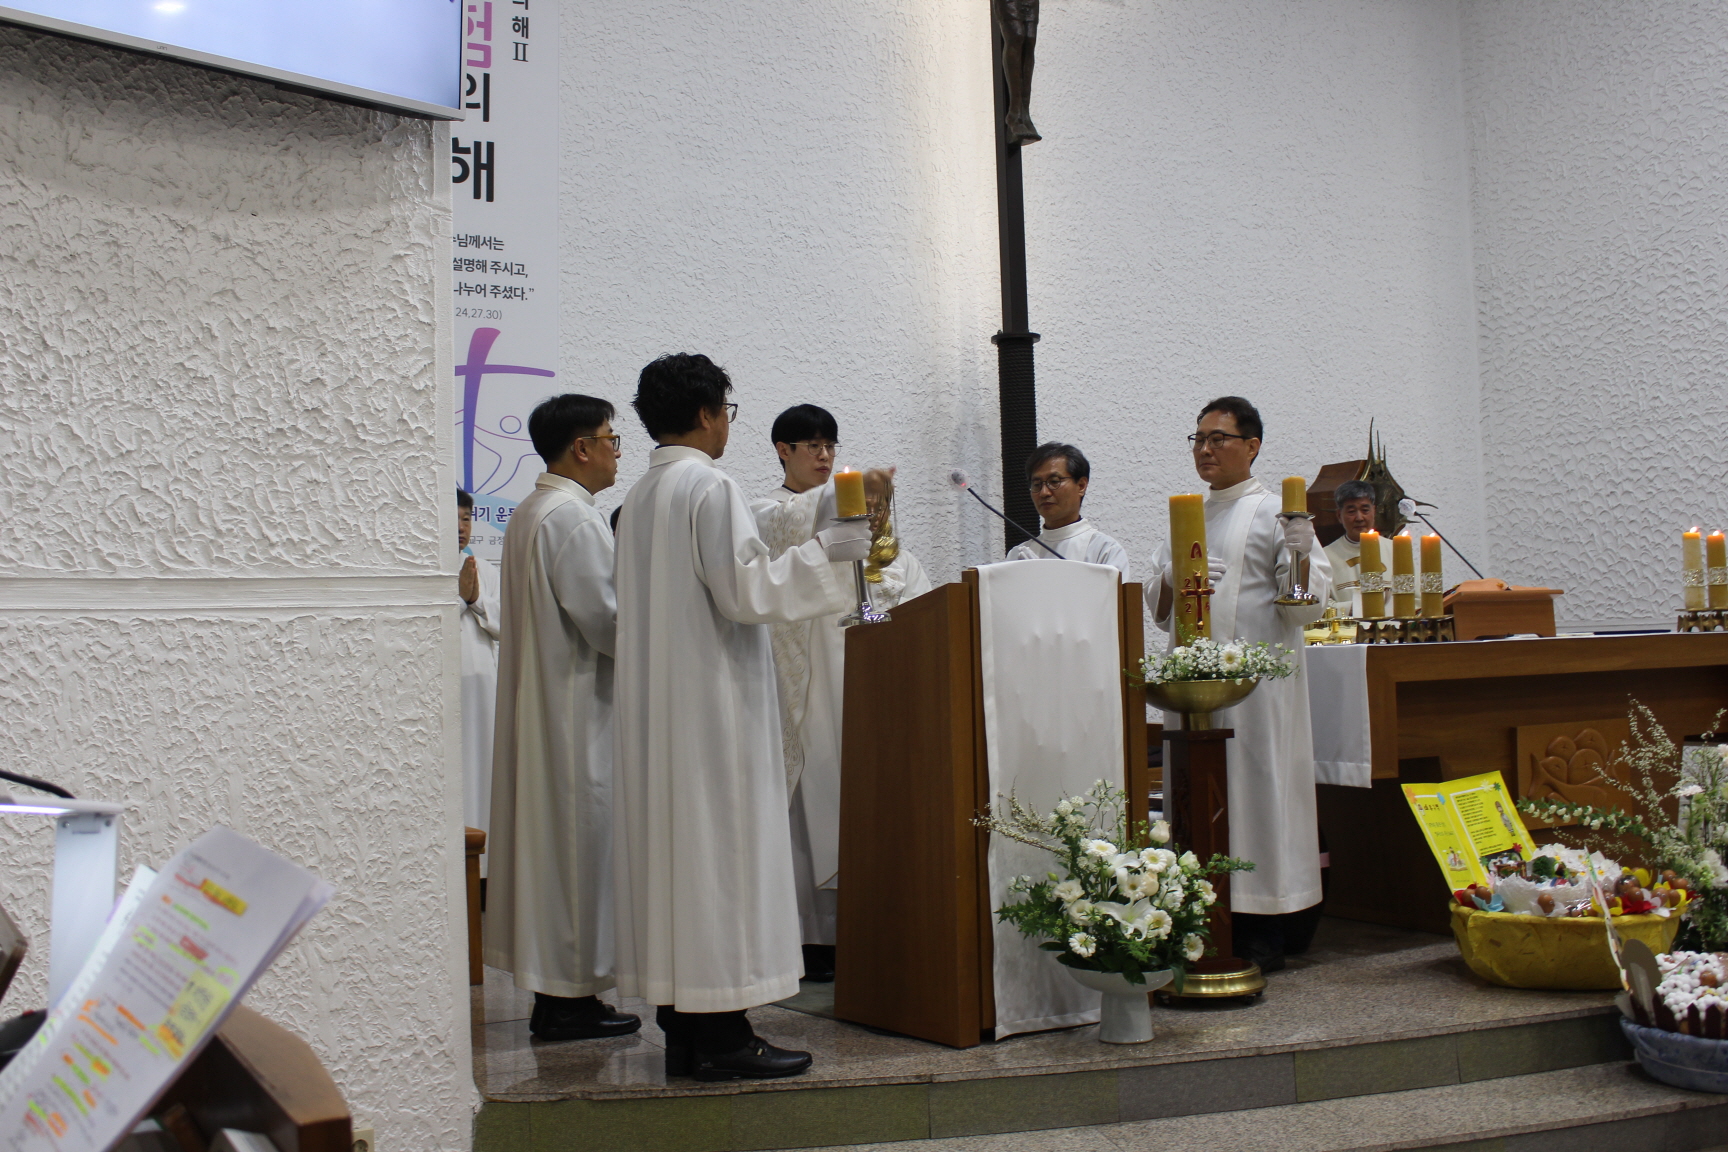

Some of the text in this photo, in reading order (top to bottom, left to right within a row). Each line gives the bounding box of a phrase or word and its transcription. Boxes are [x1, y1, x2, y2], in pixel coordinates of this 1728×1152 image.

[512, 16, 529, 39] 해
[453, 257, 528, 278] 설명해 주시고,
[1184, 578, 1192, 588] 2
[1185, 602, 1192, 613] 2
